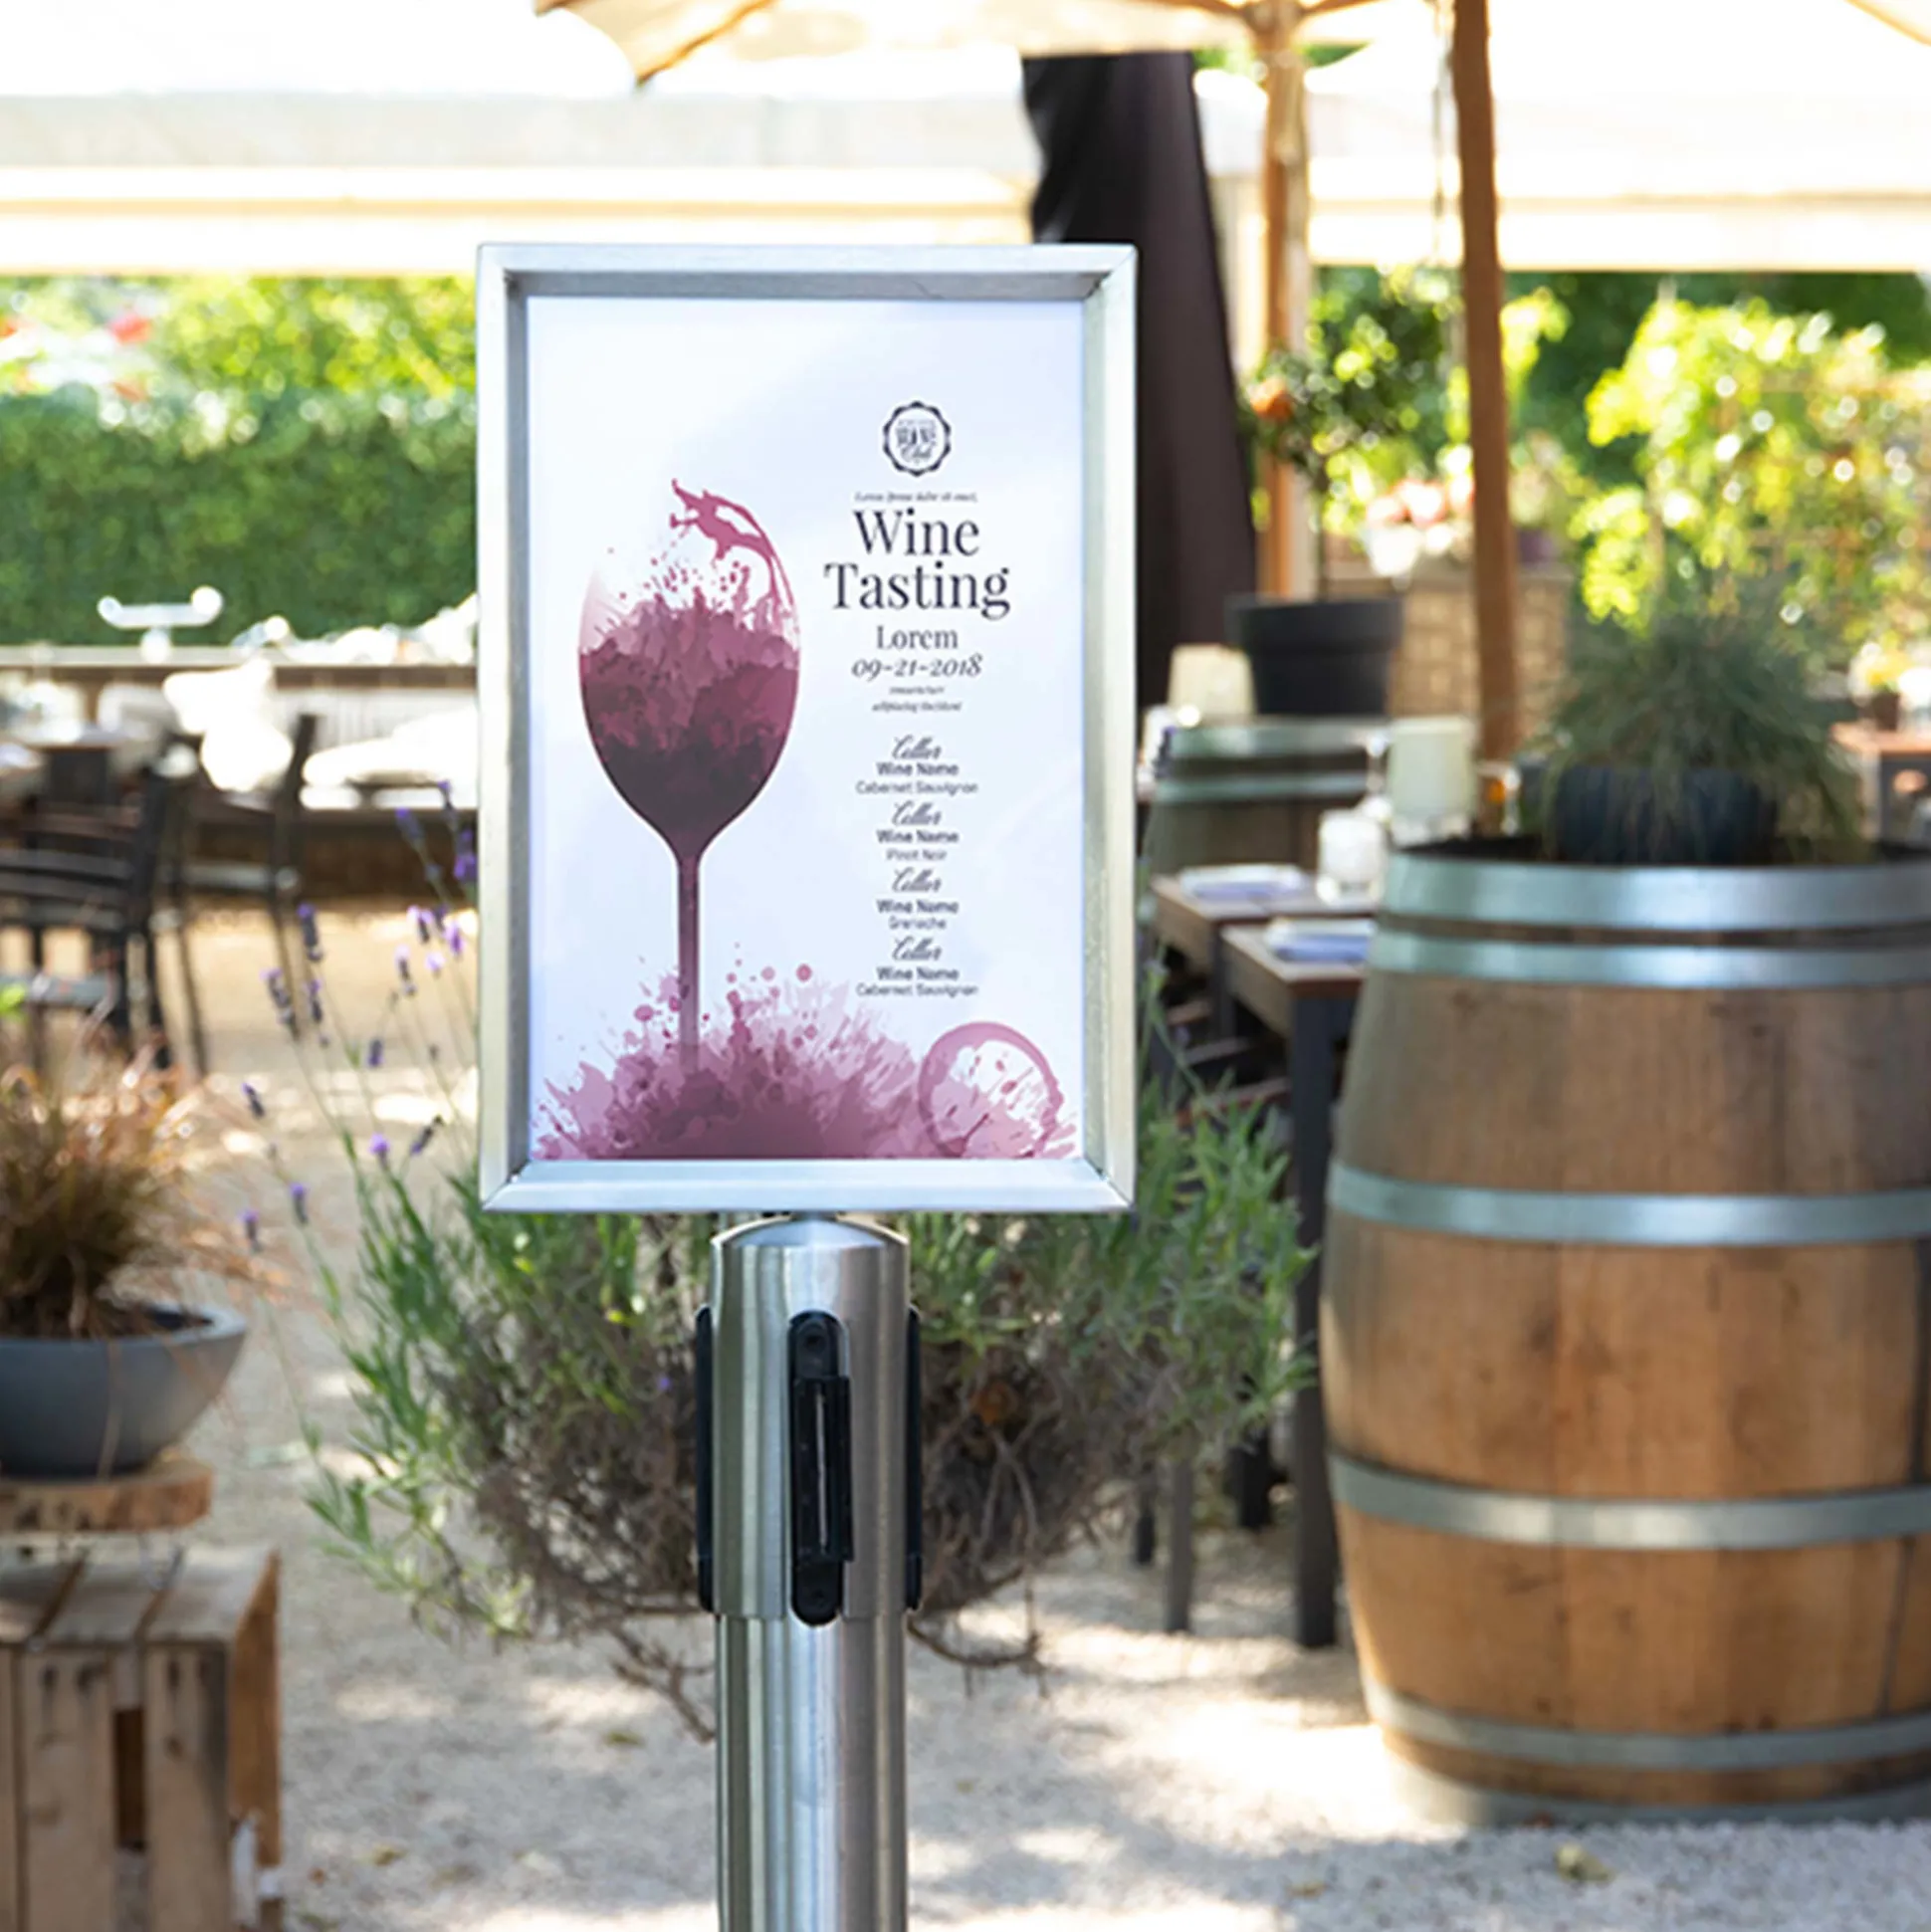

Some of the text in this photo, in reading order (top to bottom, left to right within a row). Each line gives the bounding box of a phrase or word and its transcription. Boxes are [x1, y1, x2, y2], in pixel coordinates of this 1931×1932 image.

[853, 507, 980, 557] Wine
[823, 559, 1012, 620] Tasting
[877, 625, 959, 649] Lorem
[851, 653, 983, 681] 09-21-2018
[876, 761, 960, 775] Wine Name
[856, 780, 912, 794] Cabernet
[876, 829, 960, 843] Wine Name
[876, 900, 960, 914] Wine Name
[876, 966, 960, 980] Wine Name
[856, 982, 912, 996] Cabernet
